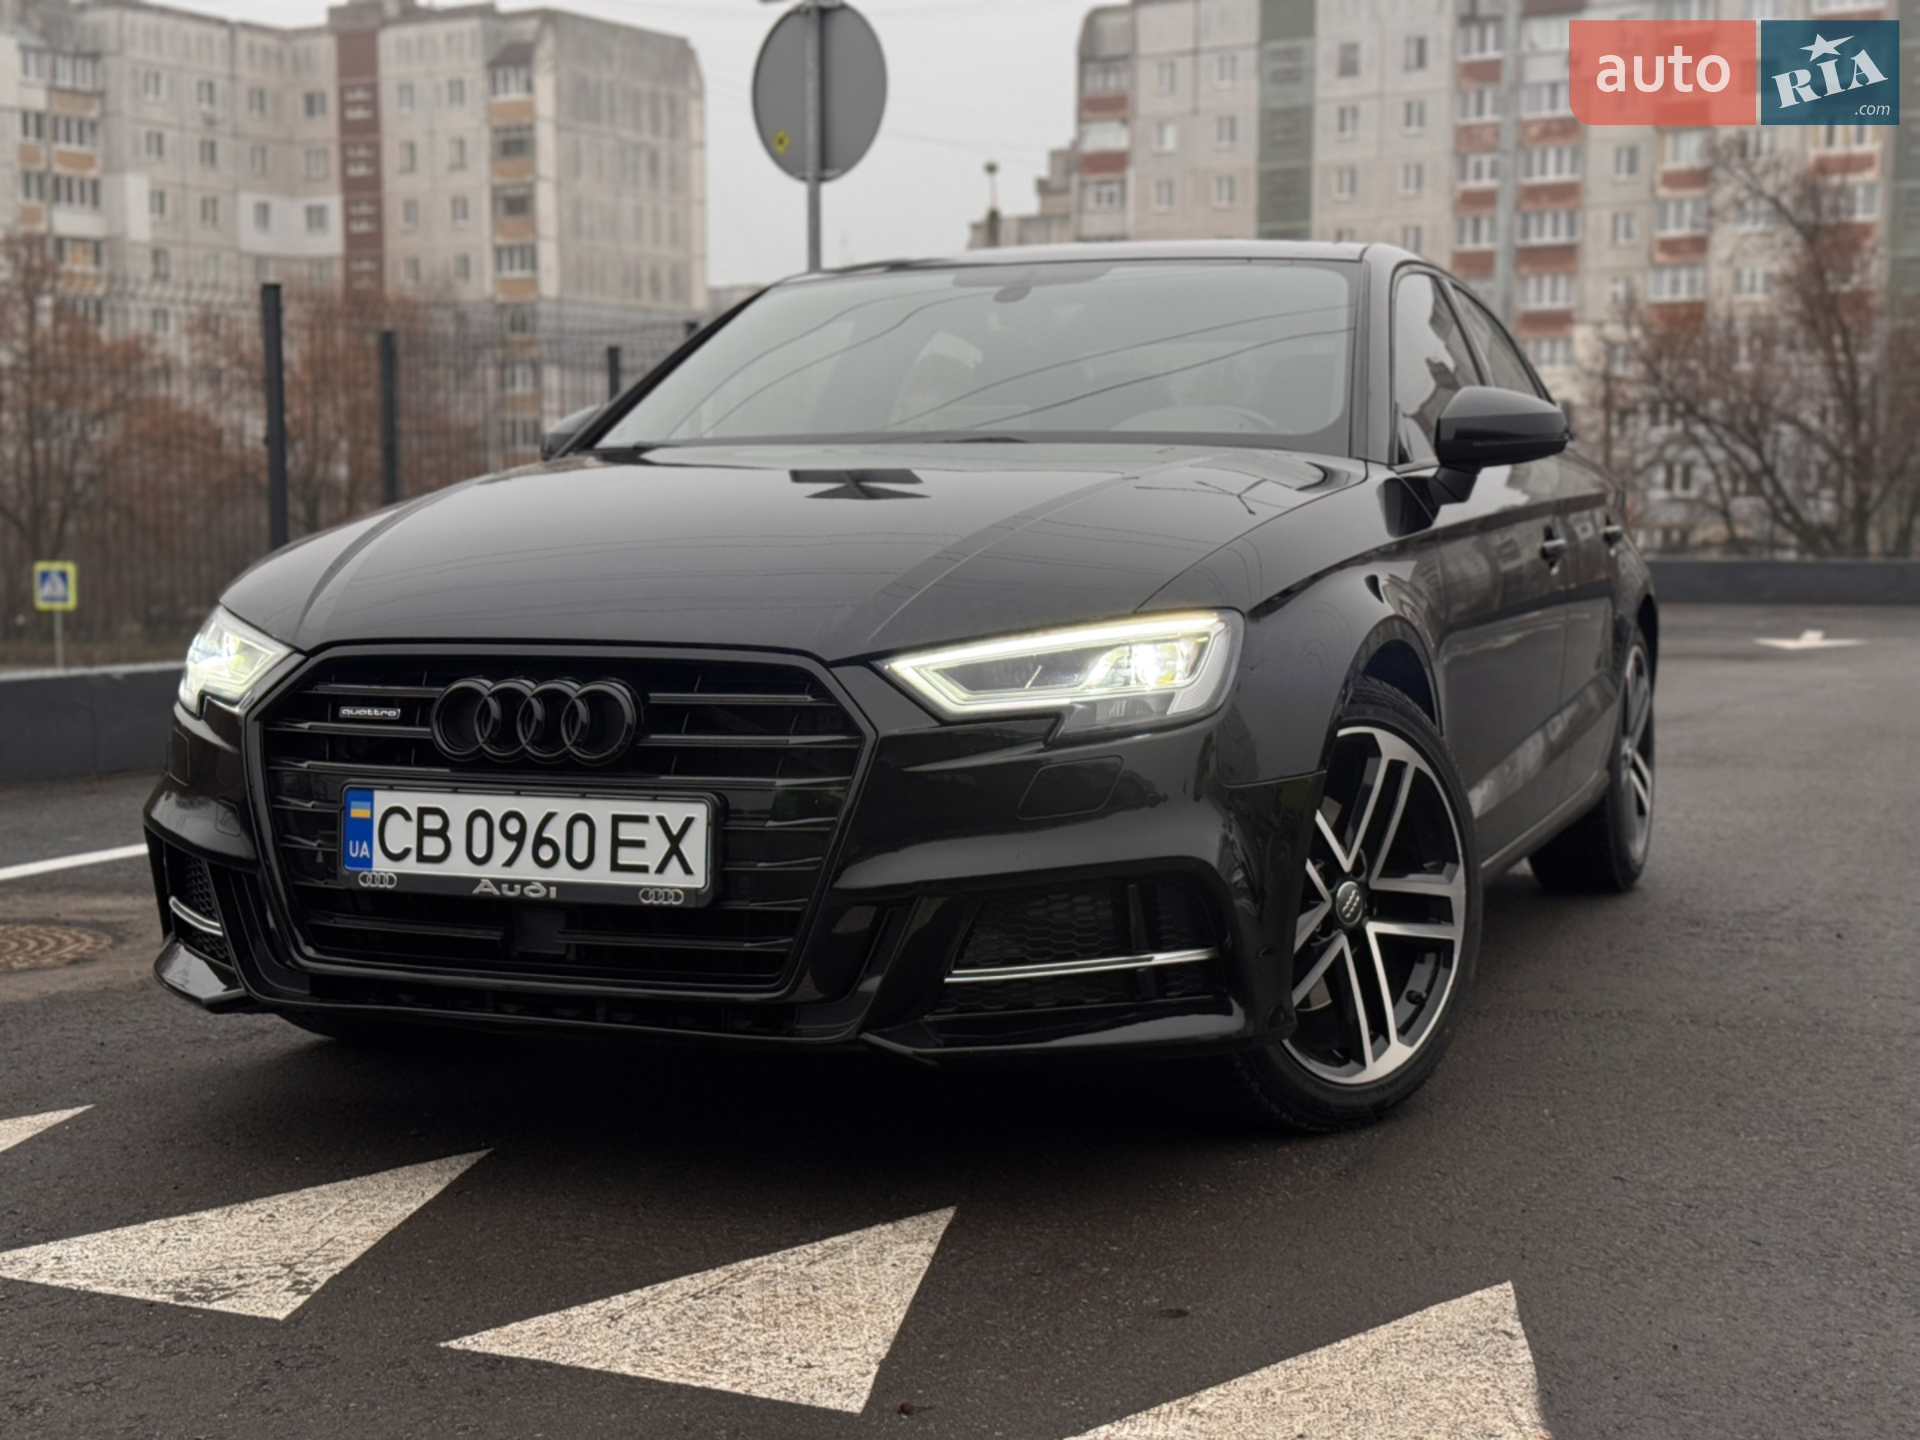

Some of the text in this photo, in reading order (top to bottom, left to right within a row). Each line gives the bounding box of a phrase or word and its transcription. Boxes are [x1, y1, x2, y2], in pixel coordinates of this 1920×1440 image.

[341, 708, 397, 717] quattro
[349, 839, 370, 859] UA
[378, 805, 696, 876] CB 0960 EX
[472, 878, 557, 899] Audi
